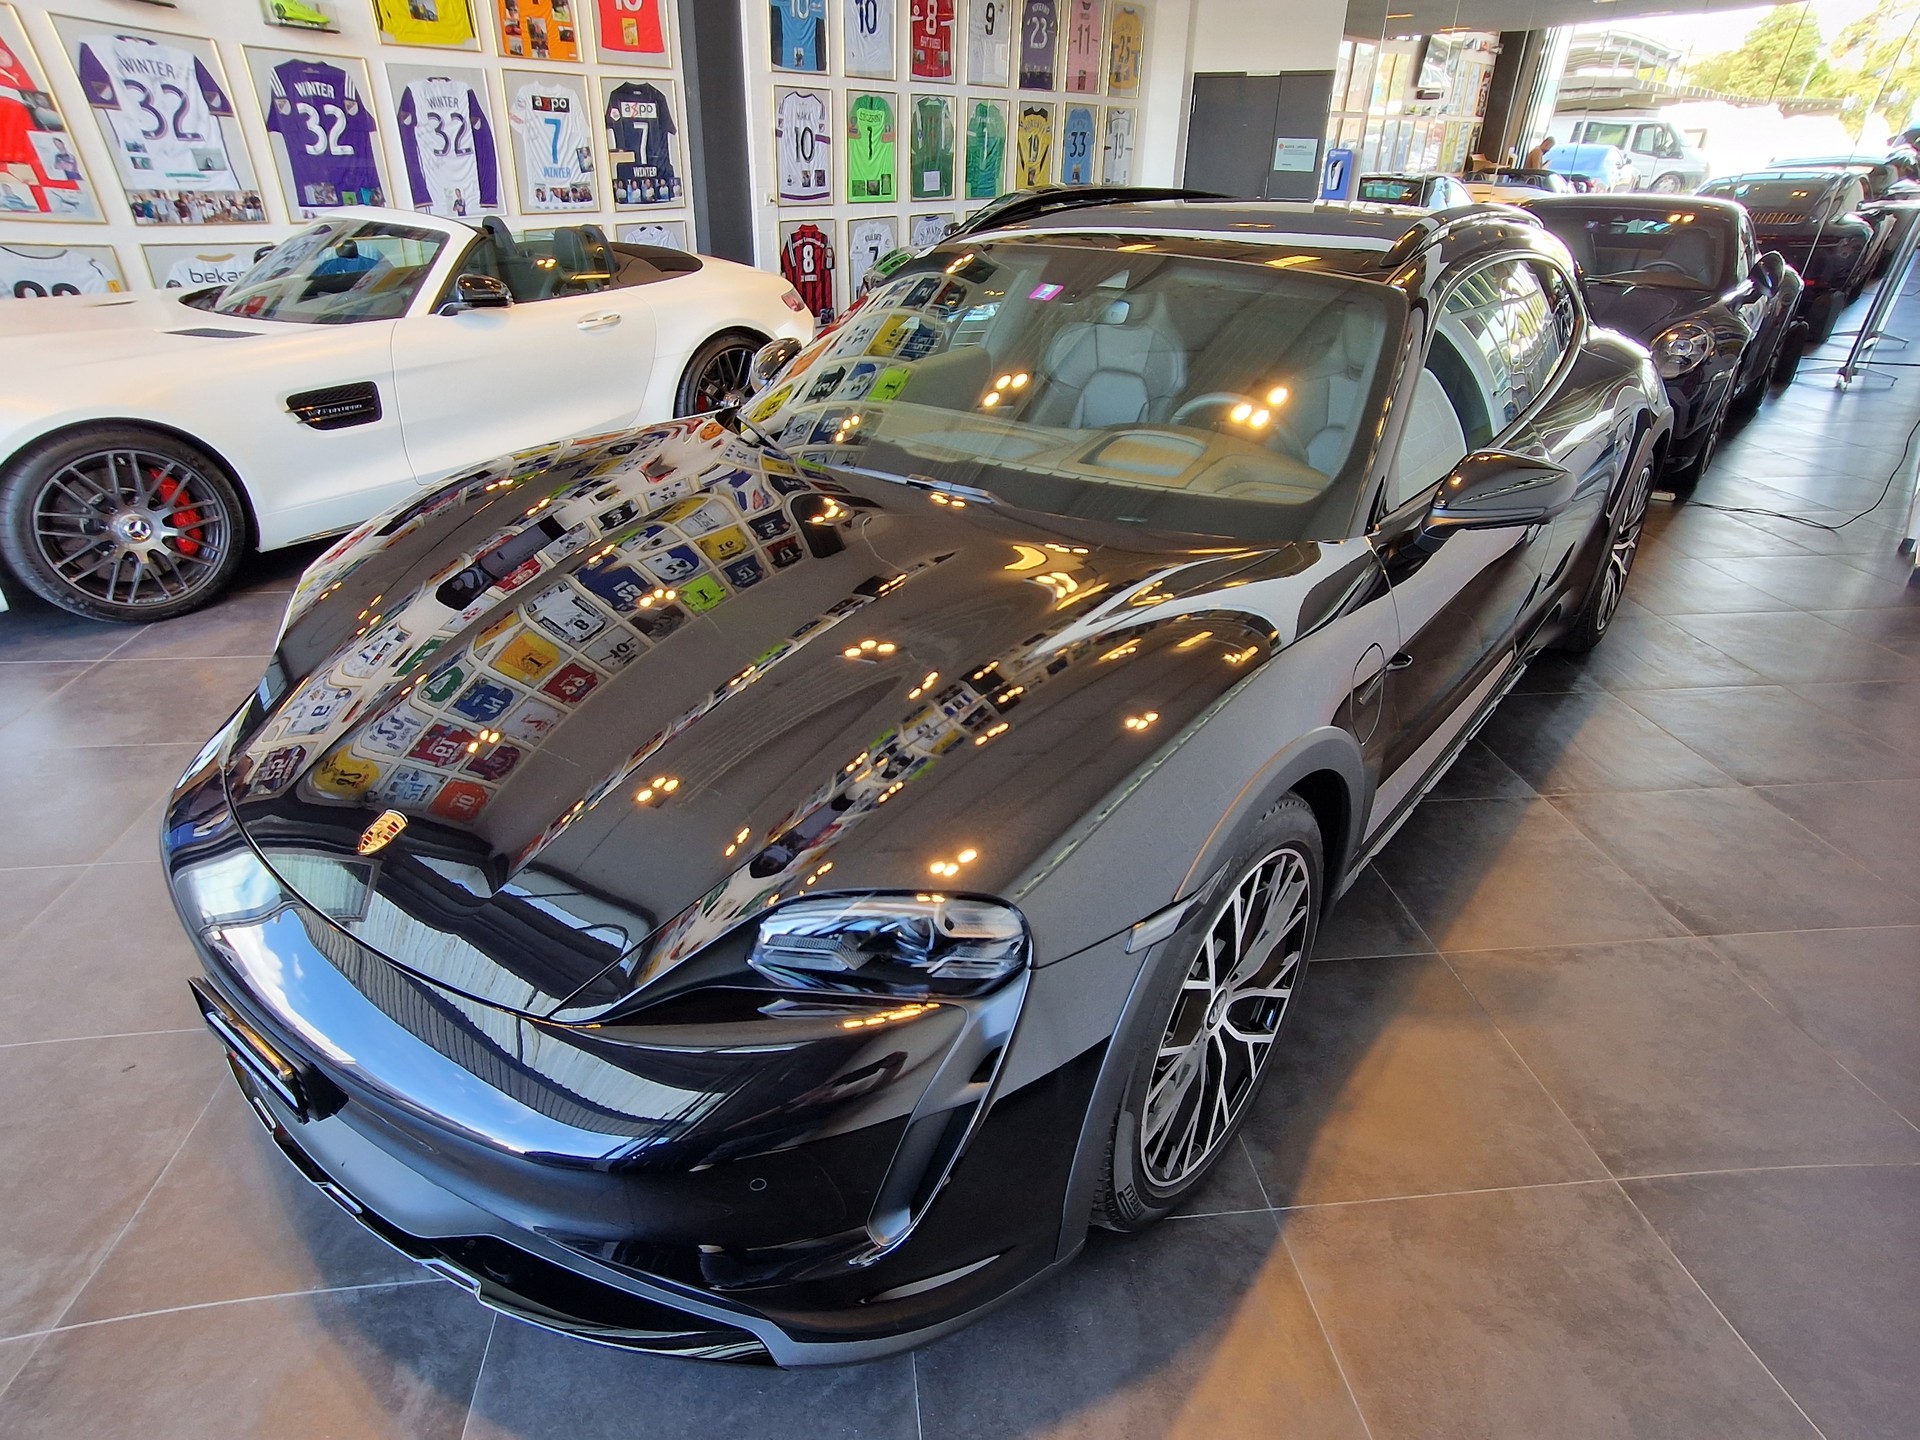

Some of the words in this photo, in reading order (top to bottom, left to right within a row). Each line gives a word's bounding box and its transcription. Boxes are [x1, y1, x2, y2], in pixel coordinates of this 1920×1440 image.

[855, 0, 878, 34] 10
[926, 0, 938, 35] 8
[985, 2, 996, 36] 9
[1030, 16, 1048, 49] 23
[1077, 23, 1092, 55] 11
[1119, 35, 1132, 64] 25
[119, 57, 177, 80] WINTER
[294, 81, 336, 99] WINTER
[426, 96, 460, 110] WINTER
[123, 79, 206, 142] 32
[296, 102, 355, 156] 32
[426, 111, 473, 157] 32
[544, 118, 562, 164] 7
[633, 122, 649, 165] 7
[794, 126, 814, 162] 10
[866, 126, 873, 160] 1
[1069, 131, 1086, 158] 33
[1027, 134, 1040, 162] 19
[1114, 132, 1125, 160] 19
[543, 166, 571, 178] WINTER
[633, 166, 658, 178] WINTER
[803, 245, 815, 274] 8
[868, 246, 879, 262] 7
